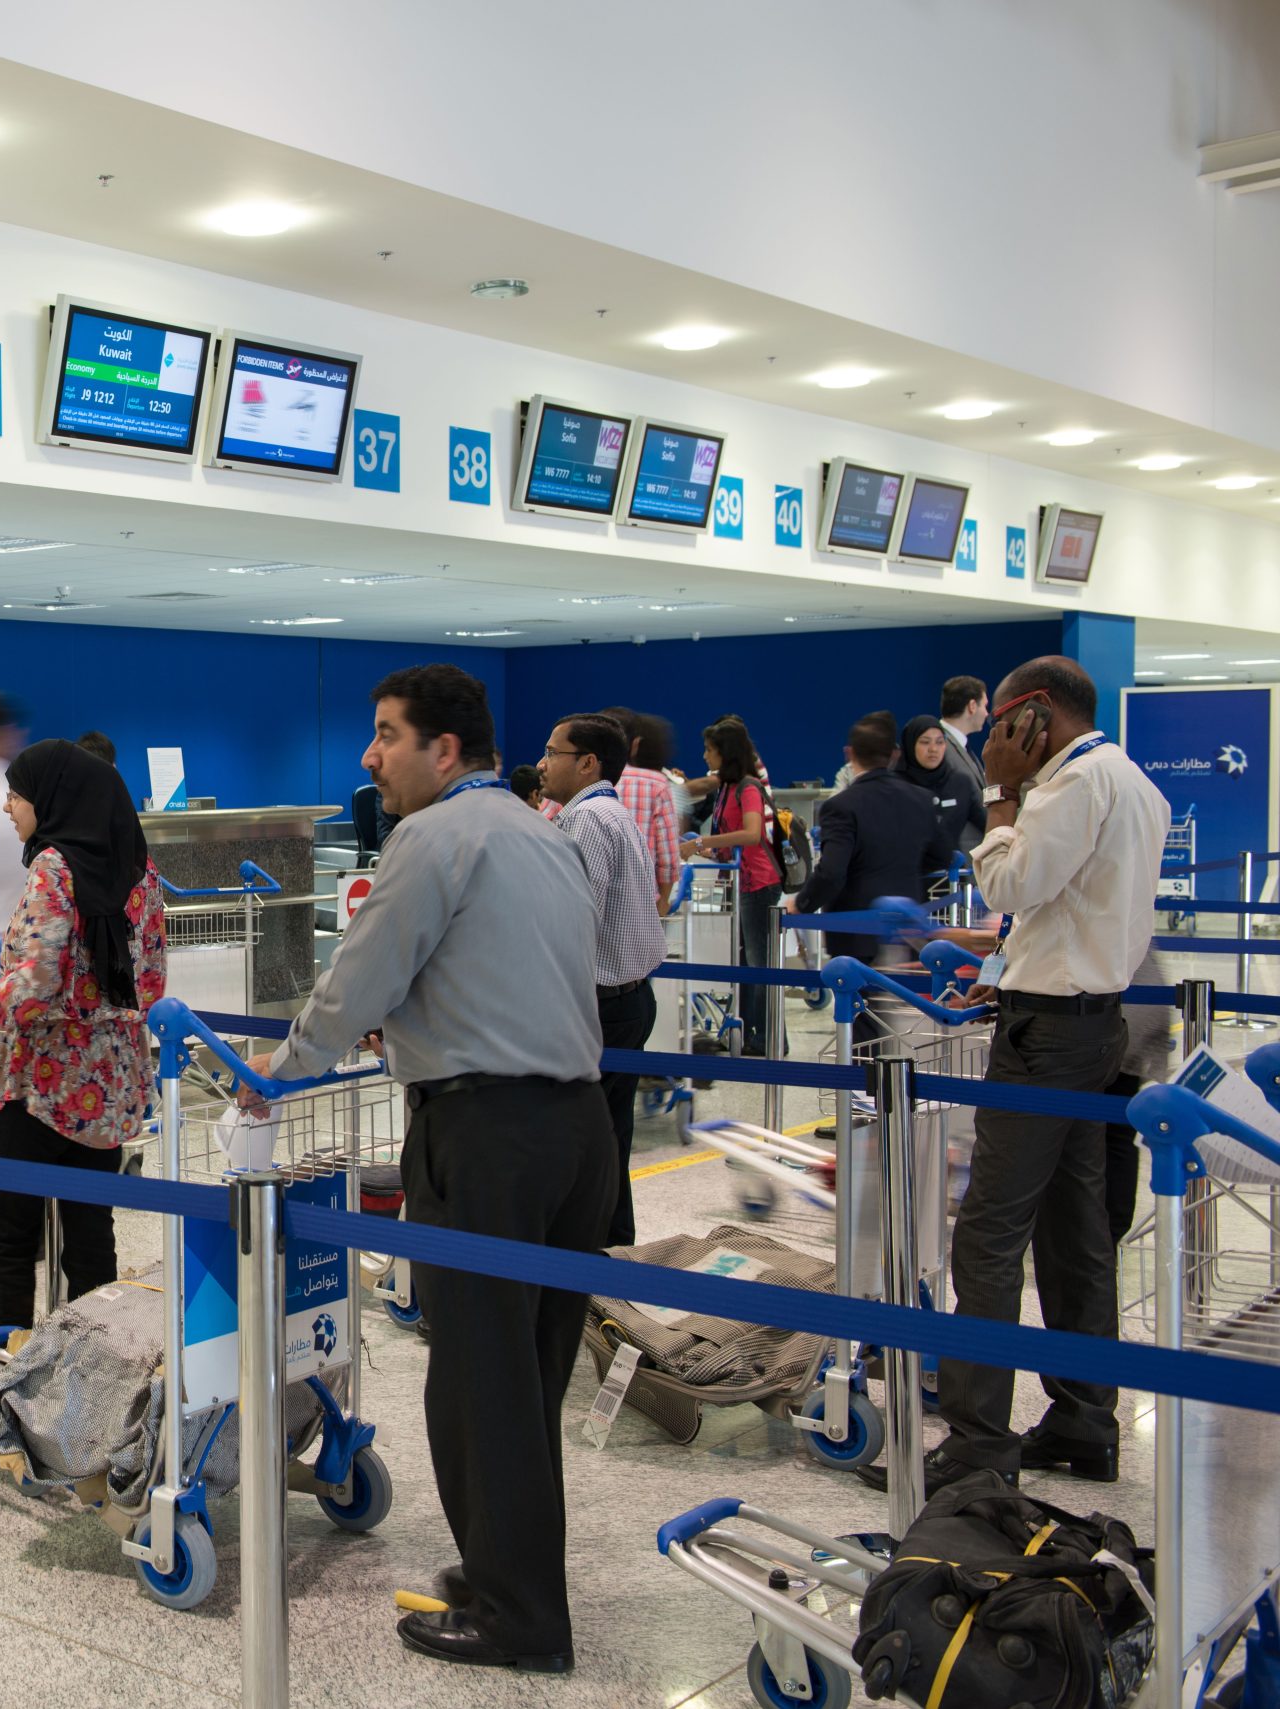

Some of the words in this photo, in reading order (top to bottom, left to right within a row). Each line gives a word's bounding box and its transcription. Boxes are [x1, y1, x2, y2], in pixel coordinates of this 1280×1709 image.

[103, 326, 132, 342] الكويت
[98, 344, 132, 361] Kuwait
[66, 361, 96, 376] Economy
[237, 354, 268, 370] FORBIDDEN
[267, 360, 284, 371] ITEMS
[116, 371, 140, 384] السياحية
[140, 375, 158, 386] الدرجة
[303, 367, 327, 379] المحظورة
[326, 373, 348, 383] الأغراض
[80, 388, 92, 400] J9
[94, 390, 115, 405] 1212
[149, 400, 172, 414] 12:50
[561, 432, 577, 444] Sofia
[359, 427, 396, 474] 37
[661, 451, 676, 462] Sofia
[453, 443, 488, 488] 38
[555, 468, 570, 479] 7777
[716, 488, 742, 527] 39
[777, 499, 801, 535] 40
[959, 530, 975, 561] 41
[1007, 538, 1025, 569] 42
[1144, 761, 1169, 772] دبي
[1171, 757, 1211, 771] مطارات
[297, 1251, 339, 1270] مستقبلنا
[303, 1275, 339, 1297] يتواصل
